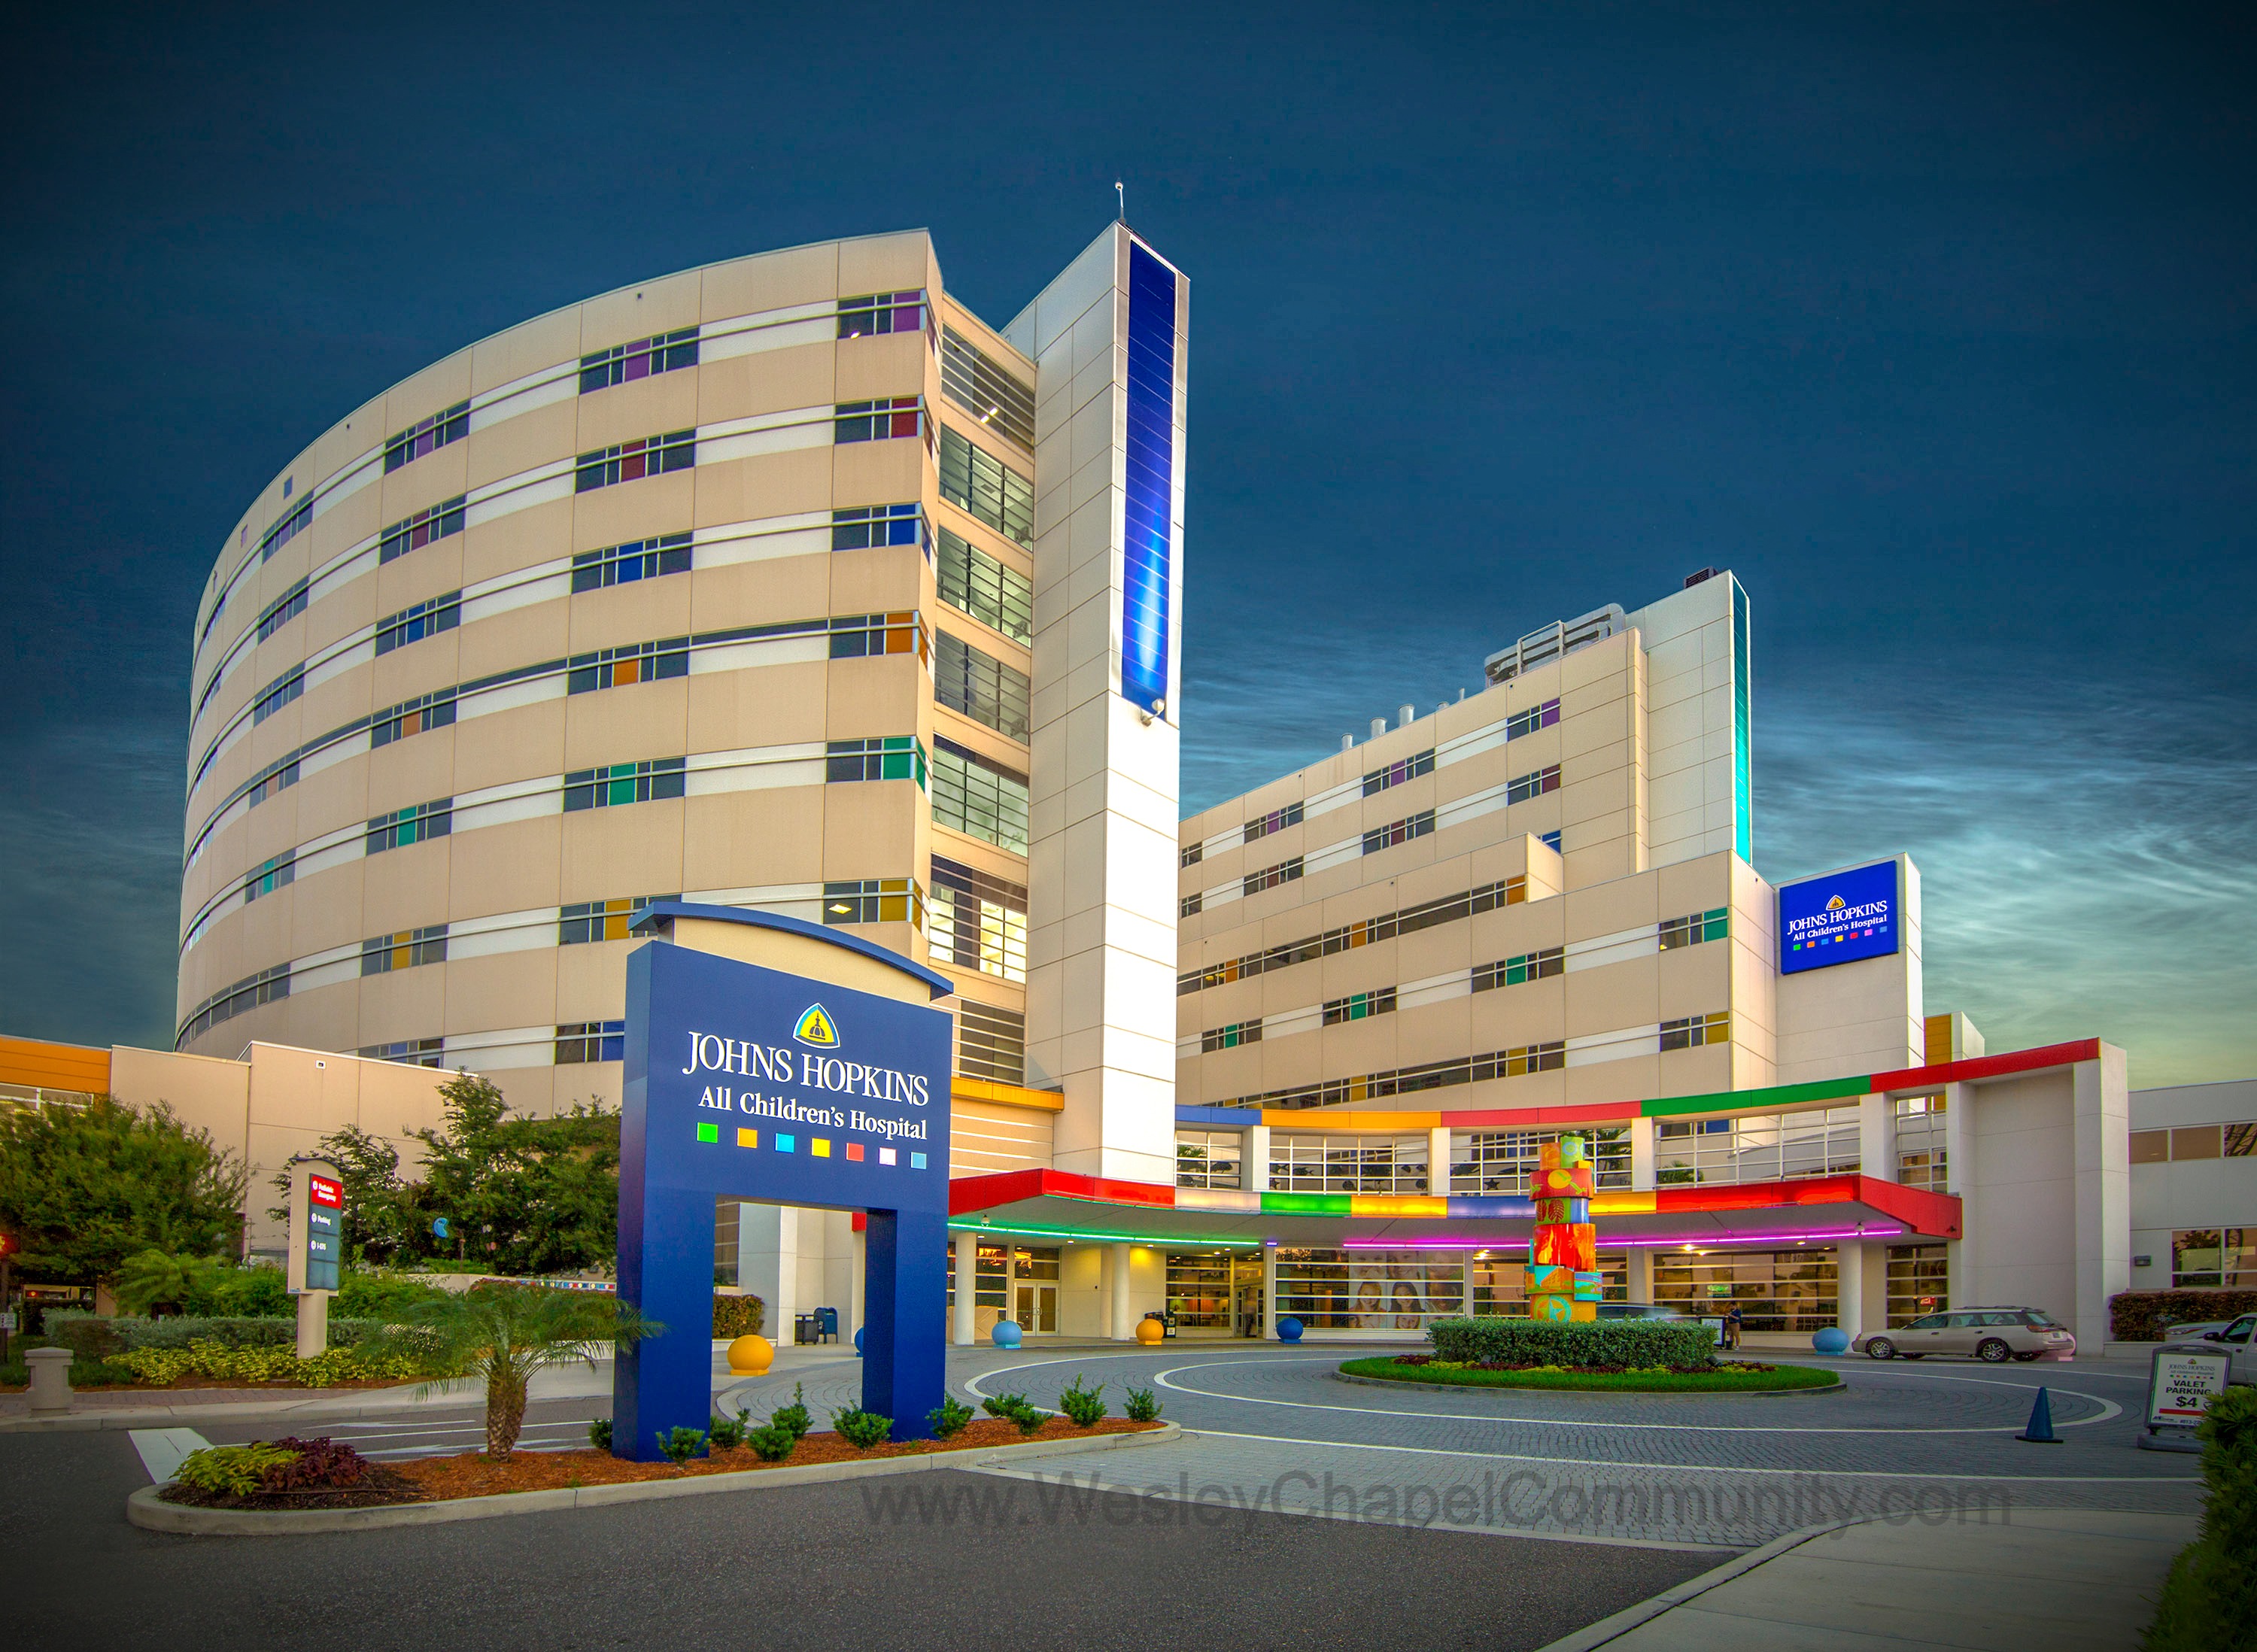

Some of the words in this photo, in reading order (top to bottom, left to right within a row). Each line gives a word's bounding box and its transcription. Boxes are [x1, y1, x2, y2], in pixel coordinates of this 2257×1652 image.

[1788, 913, 1827, 935] JOHNS
[1830, 900, 1888, 924] HOPKINS
[1794, 932, 1805, 941] All
[1807, 923, 1848, 938] Children's
[1851, 914, 1887, 930] Hospital
[682, 1031, 794, 1083] JOHNS
[800, 1053, 929, 1107] HOPKINS
[698, 1086, 732, 1111] All
[740, 1092, 844, 1128] Children's
[849, 1110, 928, 1140] Hospital
[2176, 1395, 2198, 1408] $4
